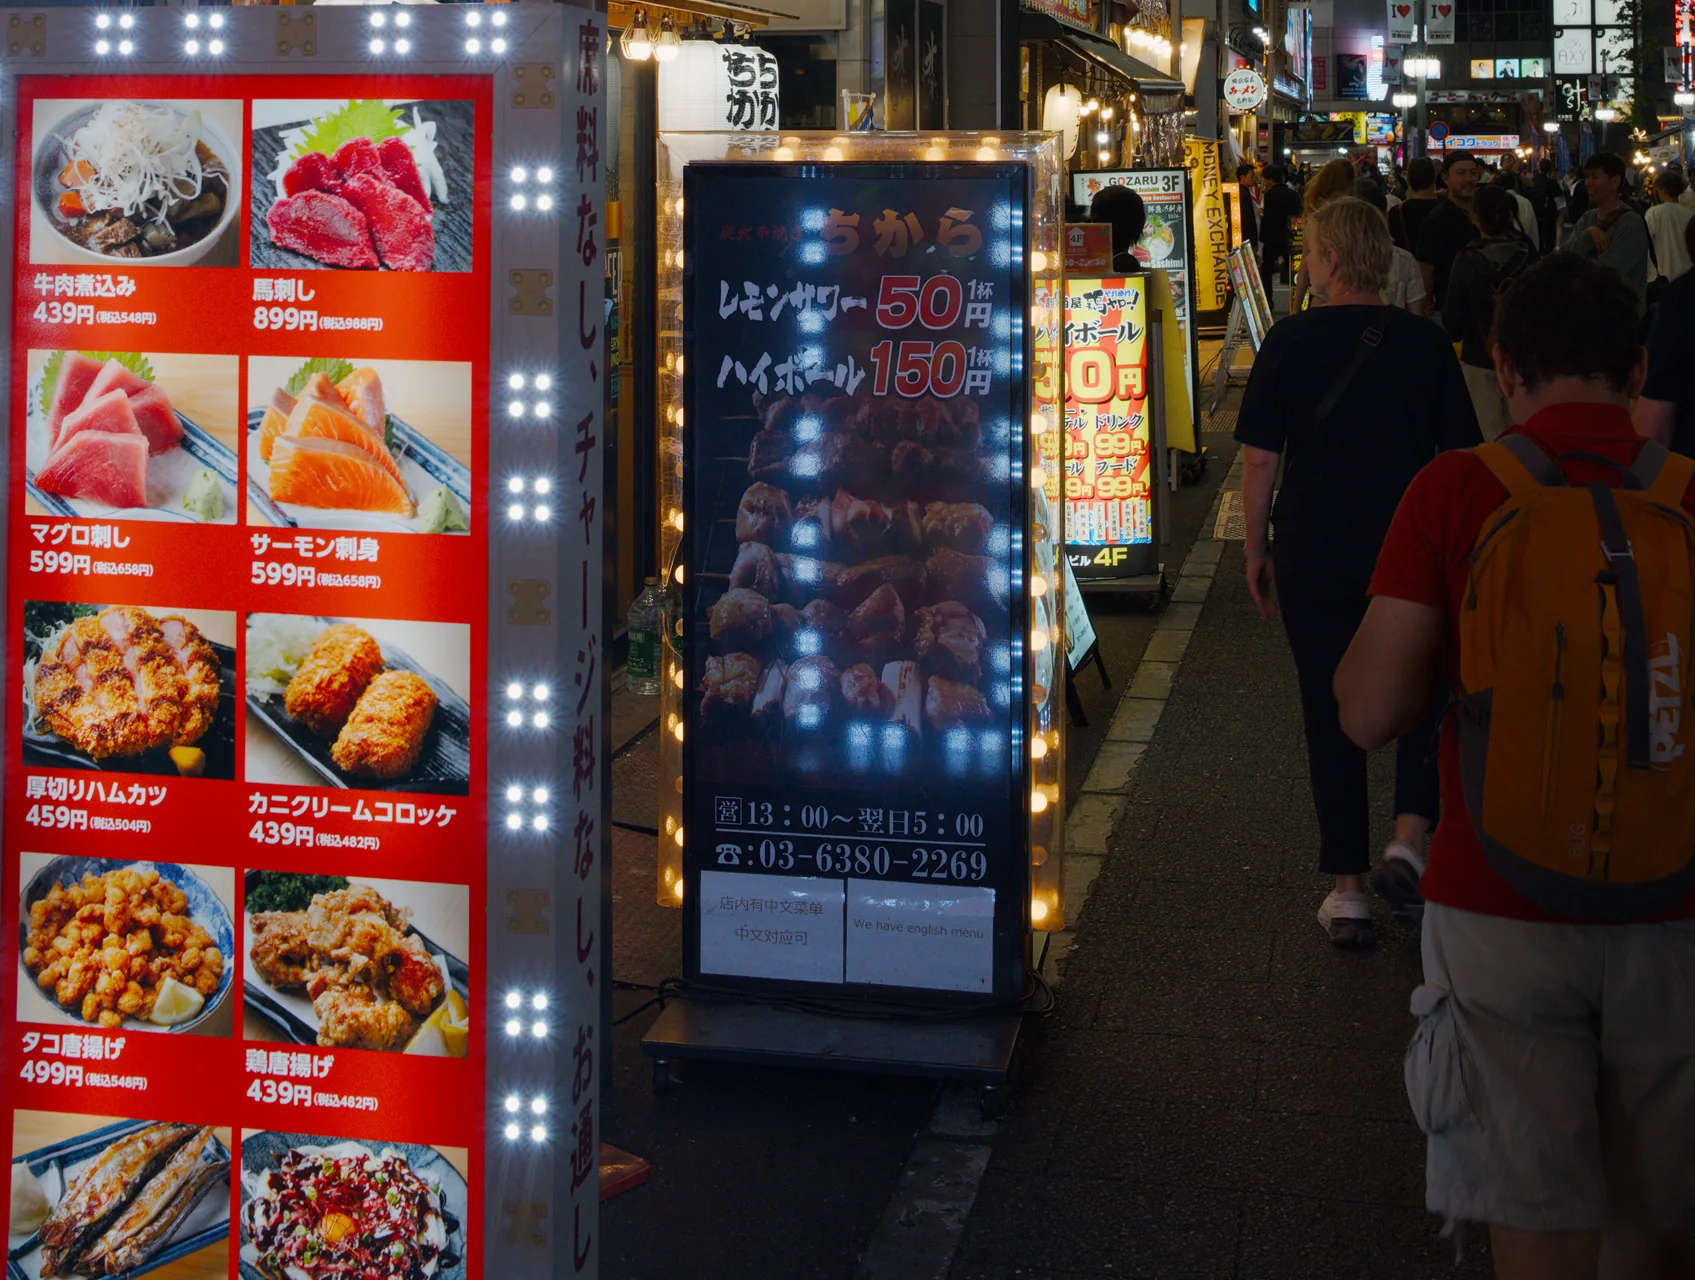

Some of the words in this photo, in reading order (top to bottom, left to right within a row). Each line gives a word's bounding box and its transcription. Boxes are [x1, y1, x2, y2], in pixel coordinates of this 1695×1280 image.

[1109, 175, 1159, 186] GOZARU
[1162, 175, 1180, 192] 3F
[1202, 141, 1220, 202] MONEY
[819, 206, 984, 258] ちから
[1152, 257, 1184, 269] Sashimi
[1205, 206, 1227, 306] EXCHANGE
[33, 272, 137, 298] 牛肉煮込み
[252, 277, 315, 302] 馬刺し
[718, 279, 868, 322] レモンサワー
[875, 274, 964, 331] 50
[716, 351, 866, 397] ハイボール
[870, 340, 967, 399] 150
[1095, 414, 1144, 431] ドリンク
[1096, 457, 1138, 475] フード
[29, 523, 131, 549] マグロ刺し
[250, 533, 380, 562] サーモン刺身
[1093, 547, 1128, 567] 4F
[1647, 632, 1686, 763] PETZL
[25, 775, 168, 807] 厚切りハムカツ
[248, 790, 457, 828] カニクリームコロッケ
[719, 895, 824, 917] 店内有中文菜单
[735, 926, 808, 946] 中文对应可
[853, 918, 872, 930] We
[876, 919, 903, 933] have
[906, 921, 948, 938] english
[951, 926, 984, 939] menu
[20, 1031, 126, 1061] タコ唐揚げ
[245, 1047, 335, 1079] 鶏唐揚げ
